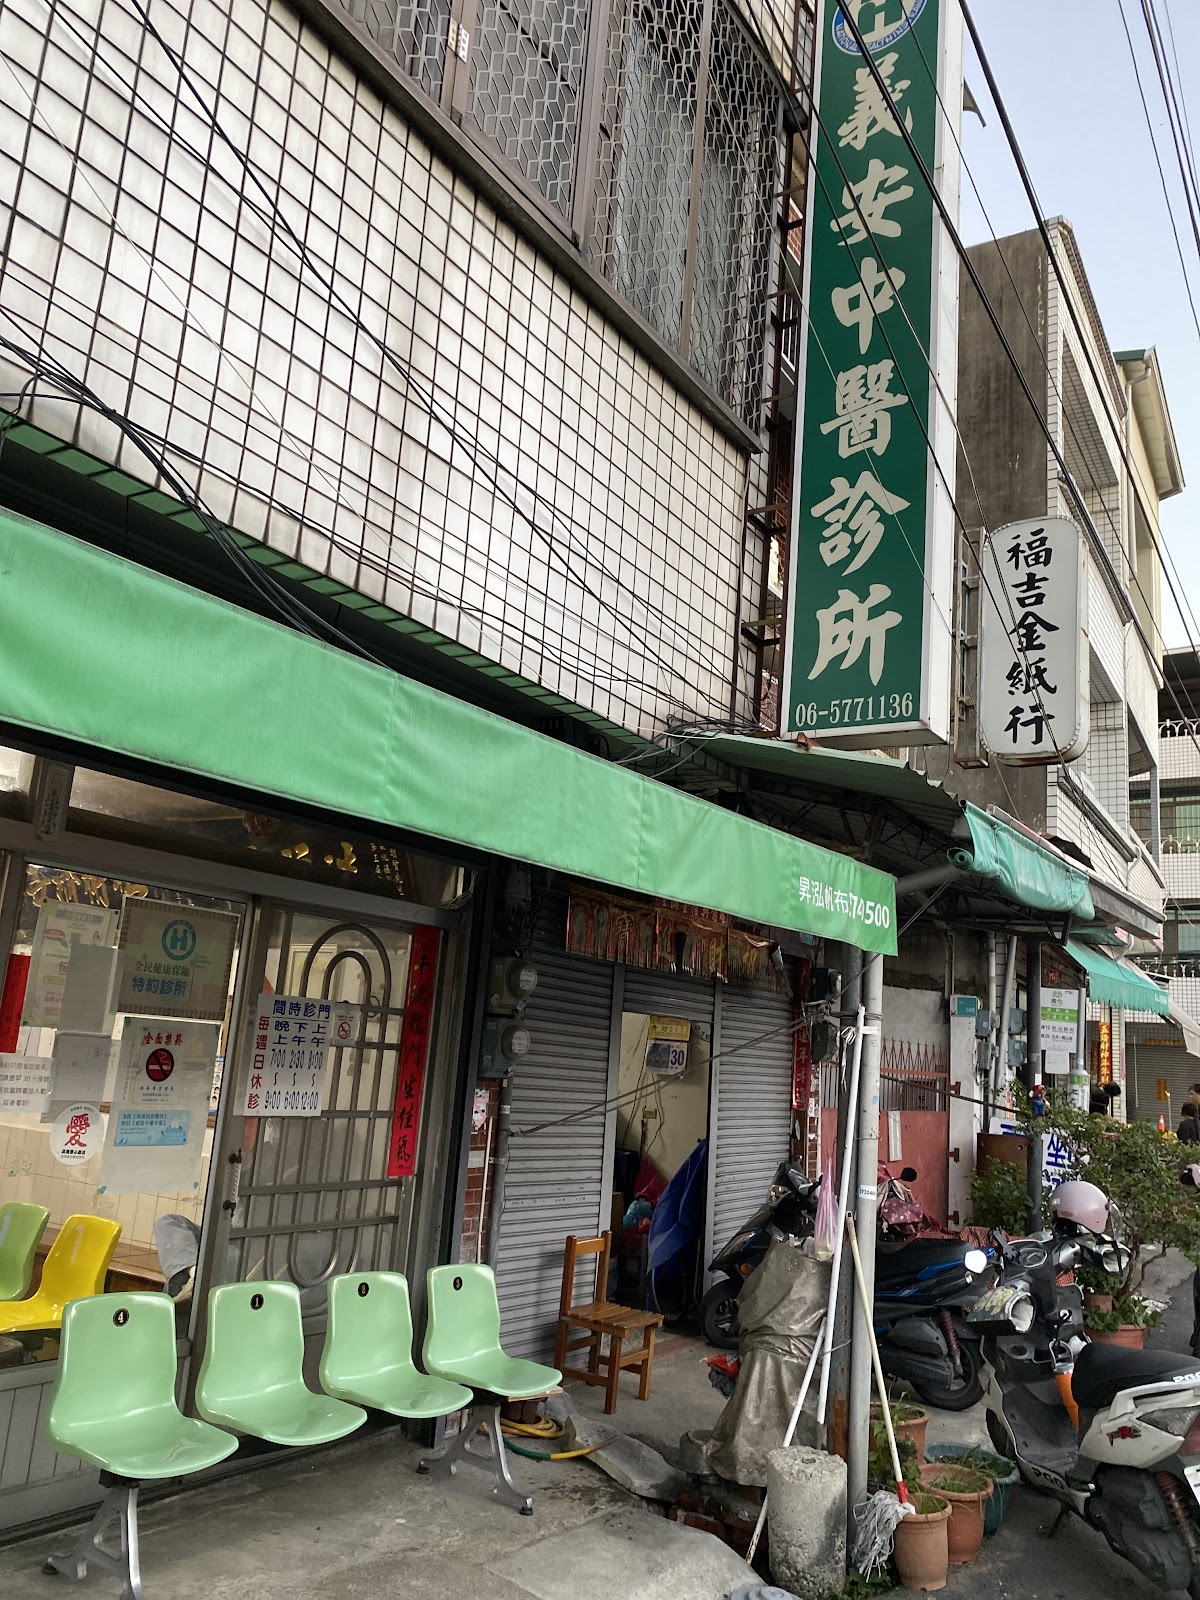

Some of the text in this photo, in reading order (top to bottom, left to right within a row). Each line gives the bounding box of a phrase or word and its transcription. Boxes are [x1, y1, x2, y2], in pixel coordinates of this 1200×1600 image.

[808, 51, 913, 687] 義安中醫診所
[1003, 526, 1059, 746] 福吉金紙行
[795, 692, 914, 728] 06-5771136
[134, 960, 191, 977] 全民健康保險
[131, 976, 188, 997] 特約診所
[247, 1015, 271, 1110] 每週日休診
[270, 1048, 287, 1068] 7:00
[288, 1049, 305, 1069] 2:30
[307, 1050, 324, 1070] 8:00
[670, 1049, 685, 1066] 30
[264, 1090, 281, 1110] 9:00
[283, 1090, 300, 1110] 6:00
[300, 1090, 319, 1111] 12:00
[1031, 1466, 1065, 1490] PGO
